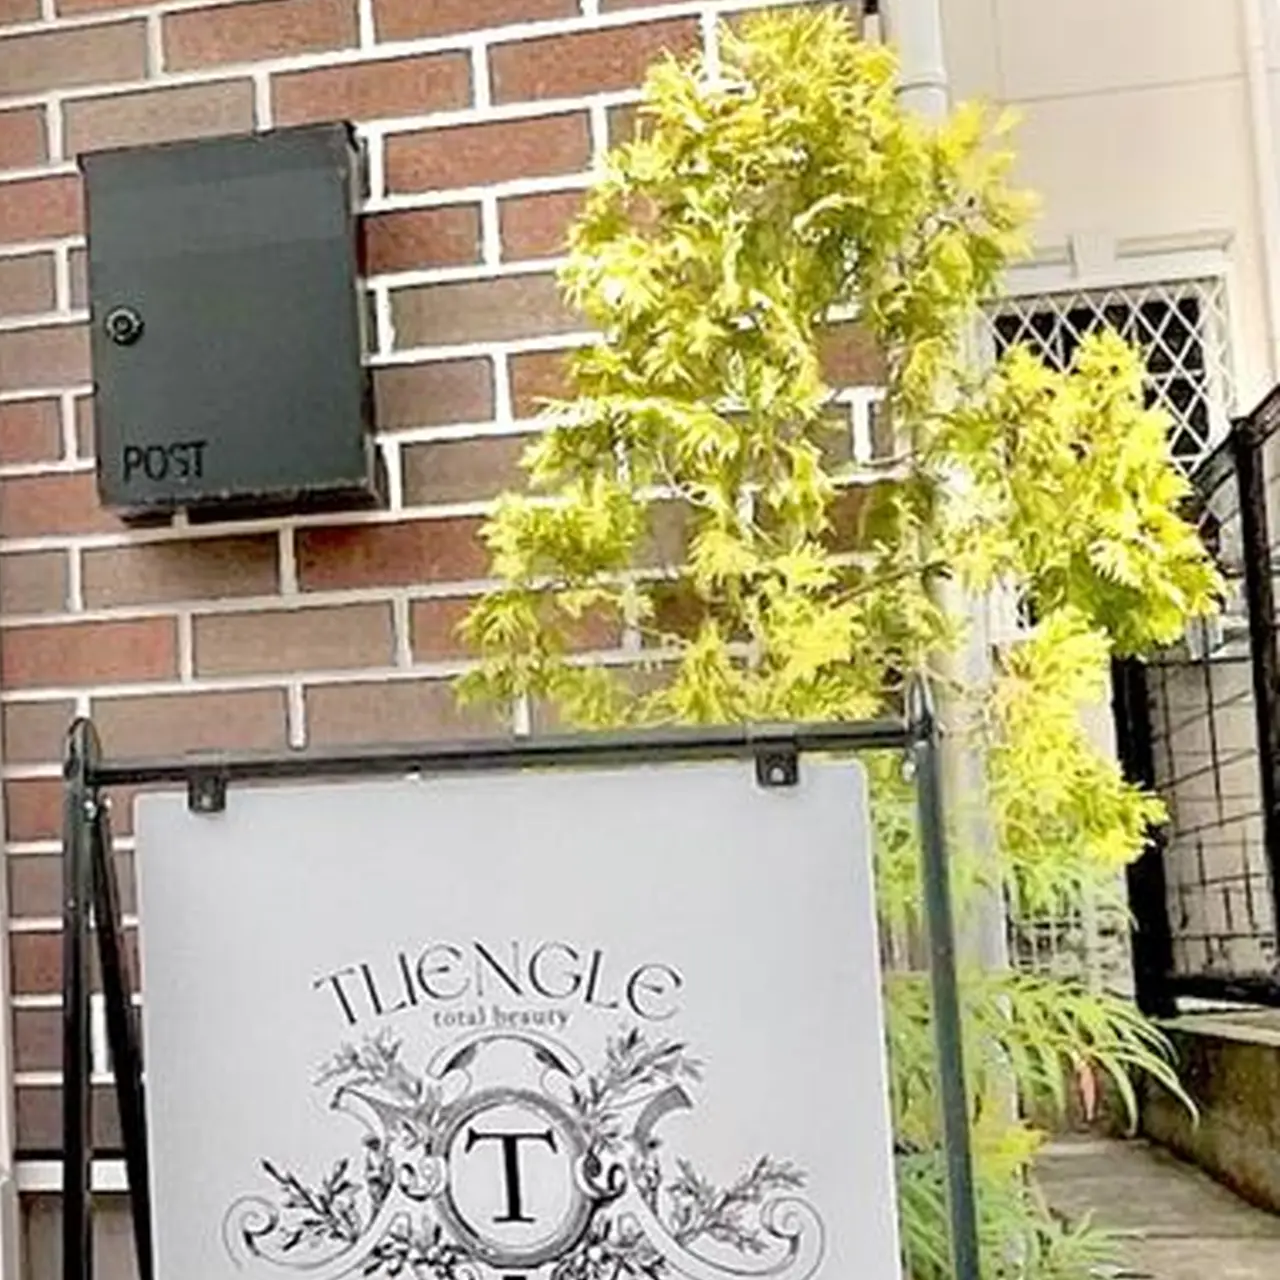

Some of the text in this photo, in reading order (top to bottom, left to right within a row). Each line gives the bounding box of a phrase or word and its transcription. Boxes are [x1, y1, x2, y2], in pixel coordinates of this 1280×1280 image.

[122, 439, 209, 483] POST
[433, 1004, 570, 1032] total beauty
[465, 1128, 557, 1223] T
